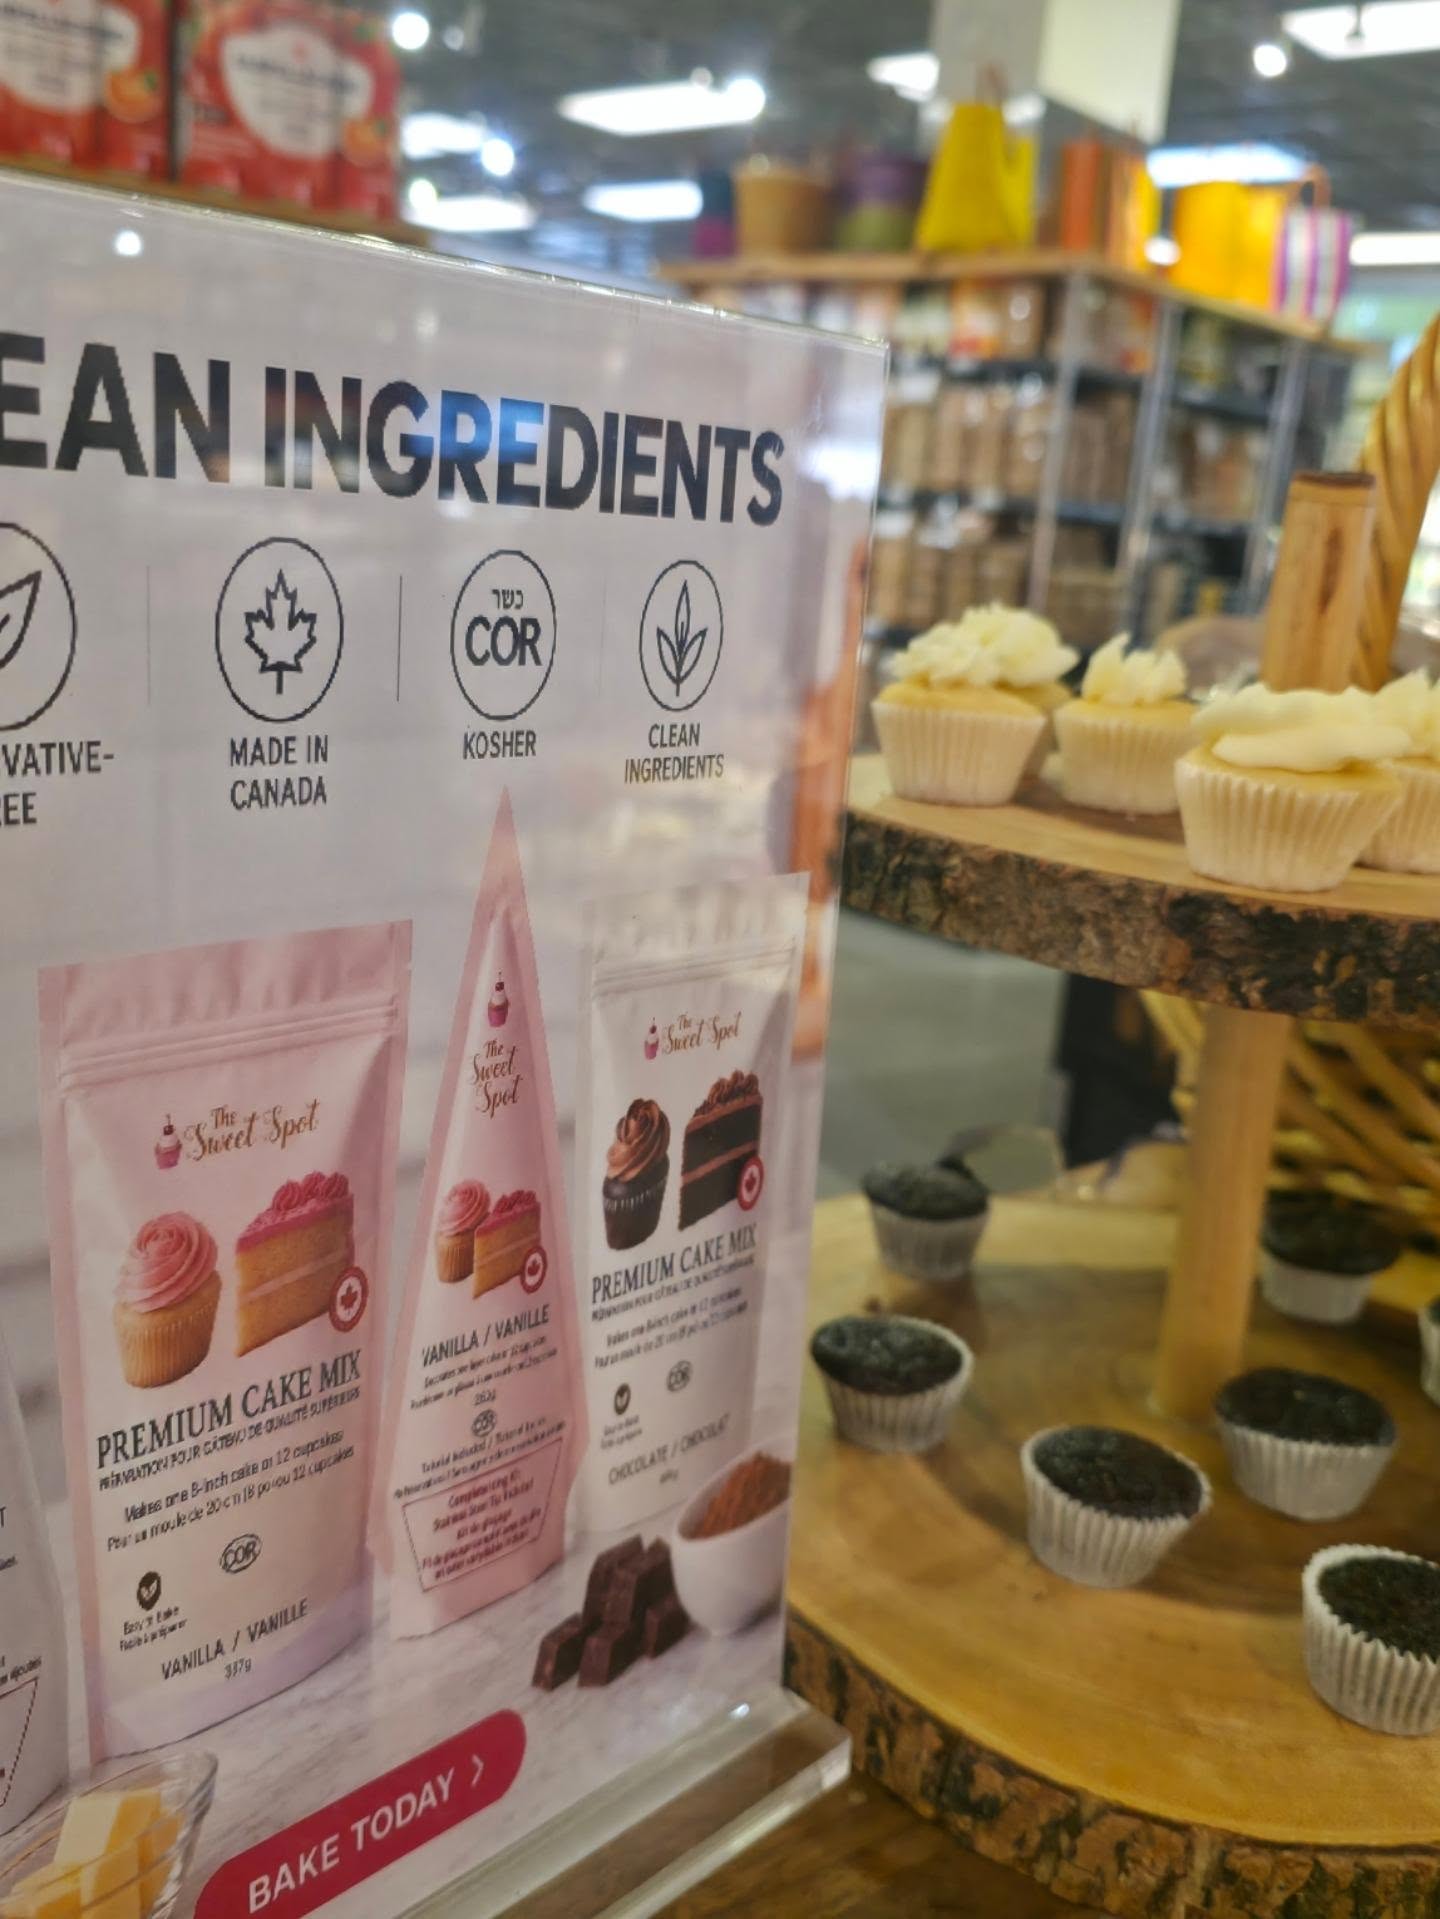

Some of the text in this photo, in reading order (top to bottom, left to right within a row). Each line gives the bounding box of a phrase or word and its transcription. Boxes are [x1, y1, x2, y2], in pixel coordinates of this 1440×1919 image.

[265, 366, 785, 527] INGREDIENTS
[492, 589, 524, 610] כשר
[465, 615, 543, 666] COR
[229, 734, 329, 767] MADE IN
[463, 730, 536, 760] KOSHER
[648, 723, 701, 749] CLEAN
[624, 754, 725, 784] INGREDIENTS
[0, 792, 37, 826] EE
[230, 775, 328, 810] CANADA
[470, 1046, 519, 1085] Sweet
[485, 1040, 504, 1058] The
[476, 1075, 523, 1119] Spot
[184, 1098, 320, 1161] Sweet Spot
[211, 1104, 237, 1129] The
[592, 1253, 675, 1304] PREMIUM
[680, 1234, 724, 1273] CAKE
[728, 1223, 757, 1256] MIX
[422, 1329, 479, 1368] VANILLA
[495, 1304, 550, 1339] VANILLE
[97, 1392, 233, 1469] PREMIUM
[241, 1366, 312, 1418] CAKE
[319, 1349, 362, 1393] MIX
[222, 1538, 259, 1569] COR
[162, 1638, 225, 1680] VANILLA
[232, 1629, 240, 1653] /
[247, 1597, 308, 1642] VANILLE
[249, 1767, 455, 1914] BAKE TODAY
